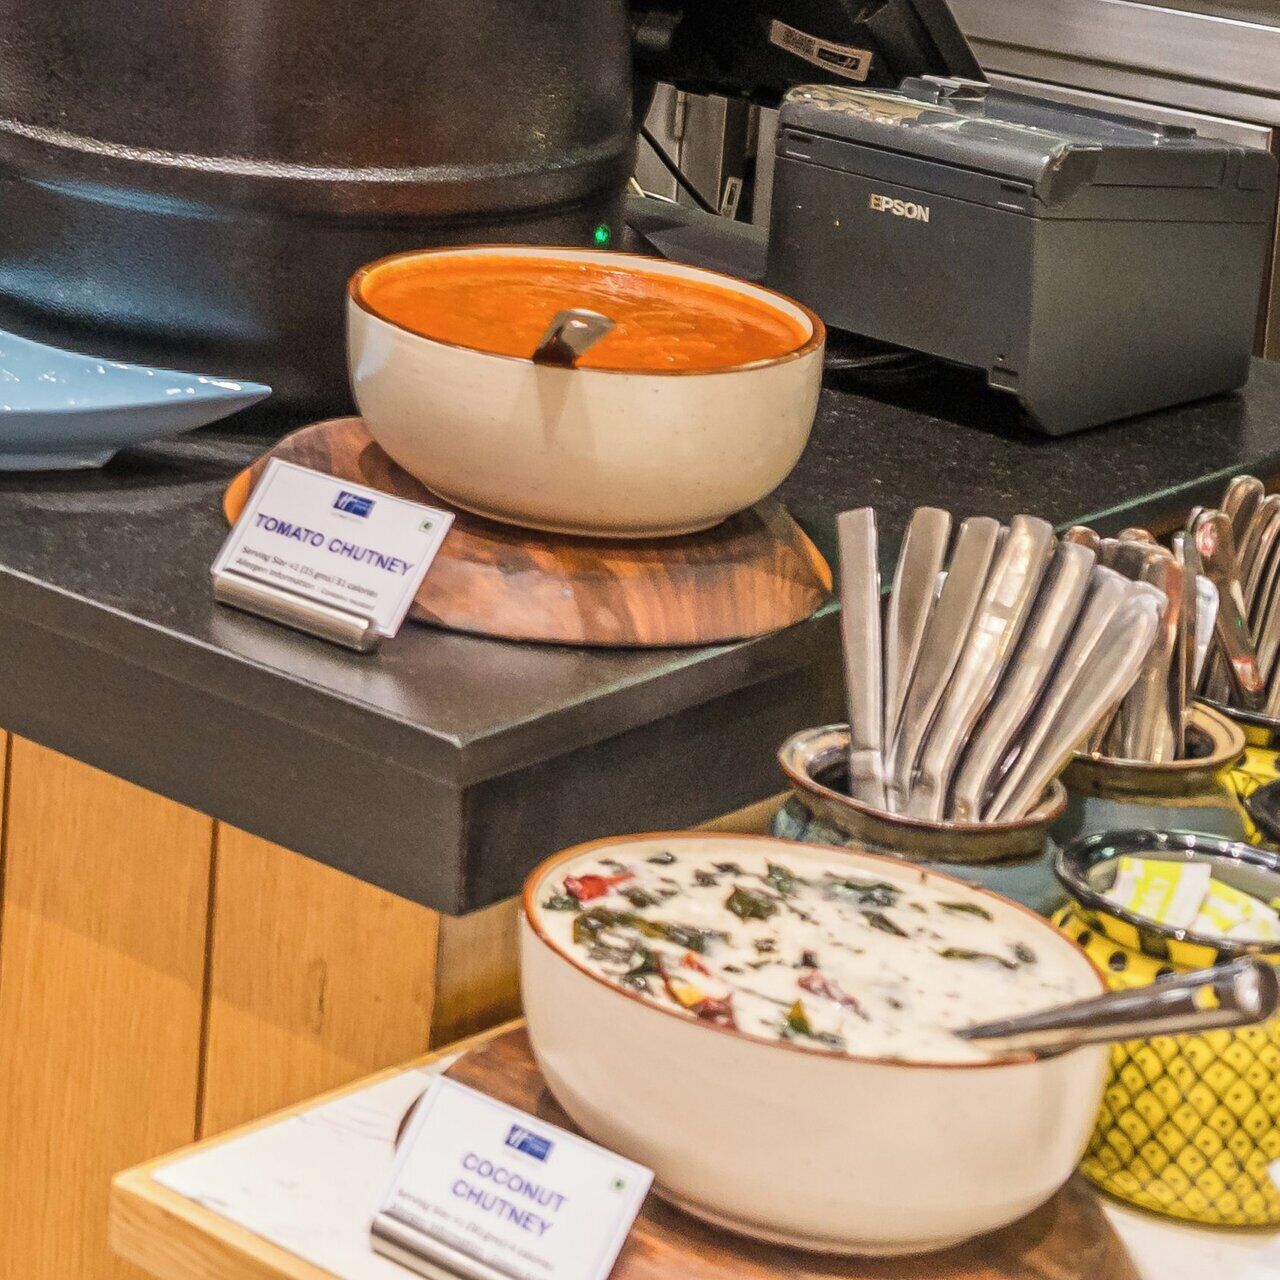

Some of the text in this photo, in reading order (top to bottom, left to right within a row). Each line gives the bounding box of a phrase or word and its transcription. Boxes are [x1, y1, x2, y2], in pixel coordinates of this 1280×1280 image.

[869, 192, 930, 223] EPSON
[255, 513, 416, 577] TOMATO CHUTNEY
[451, 1179, 554, 1237] CHUTNEY
[462, 1152, 568, 1213] COCONUT
